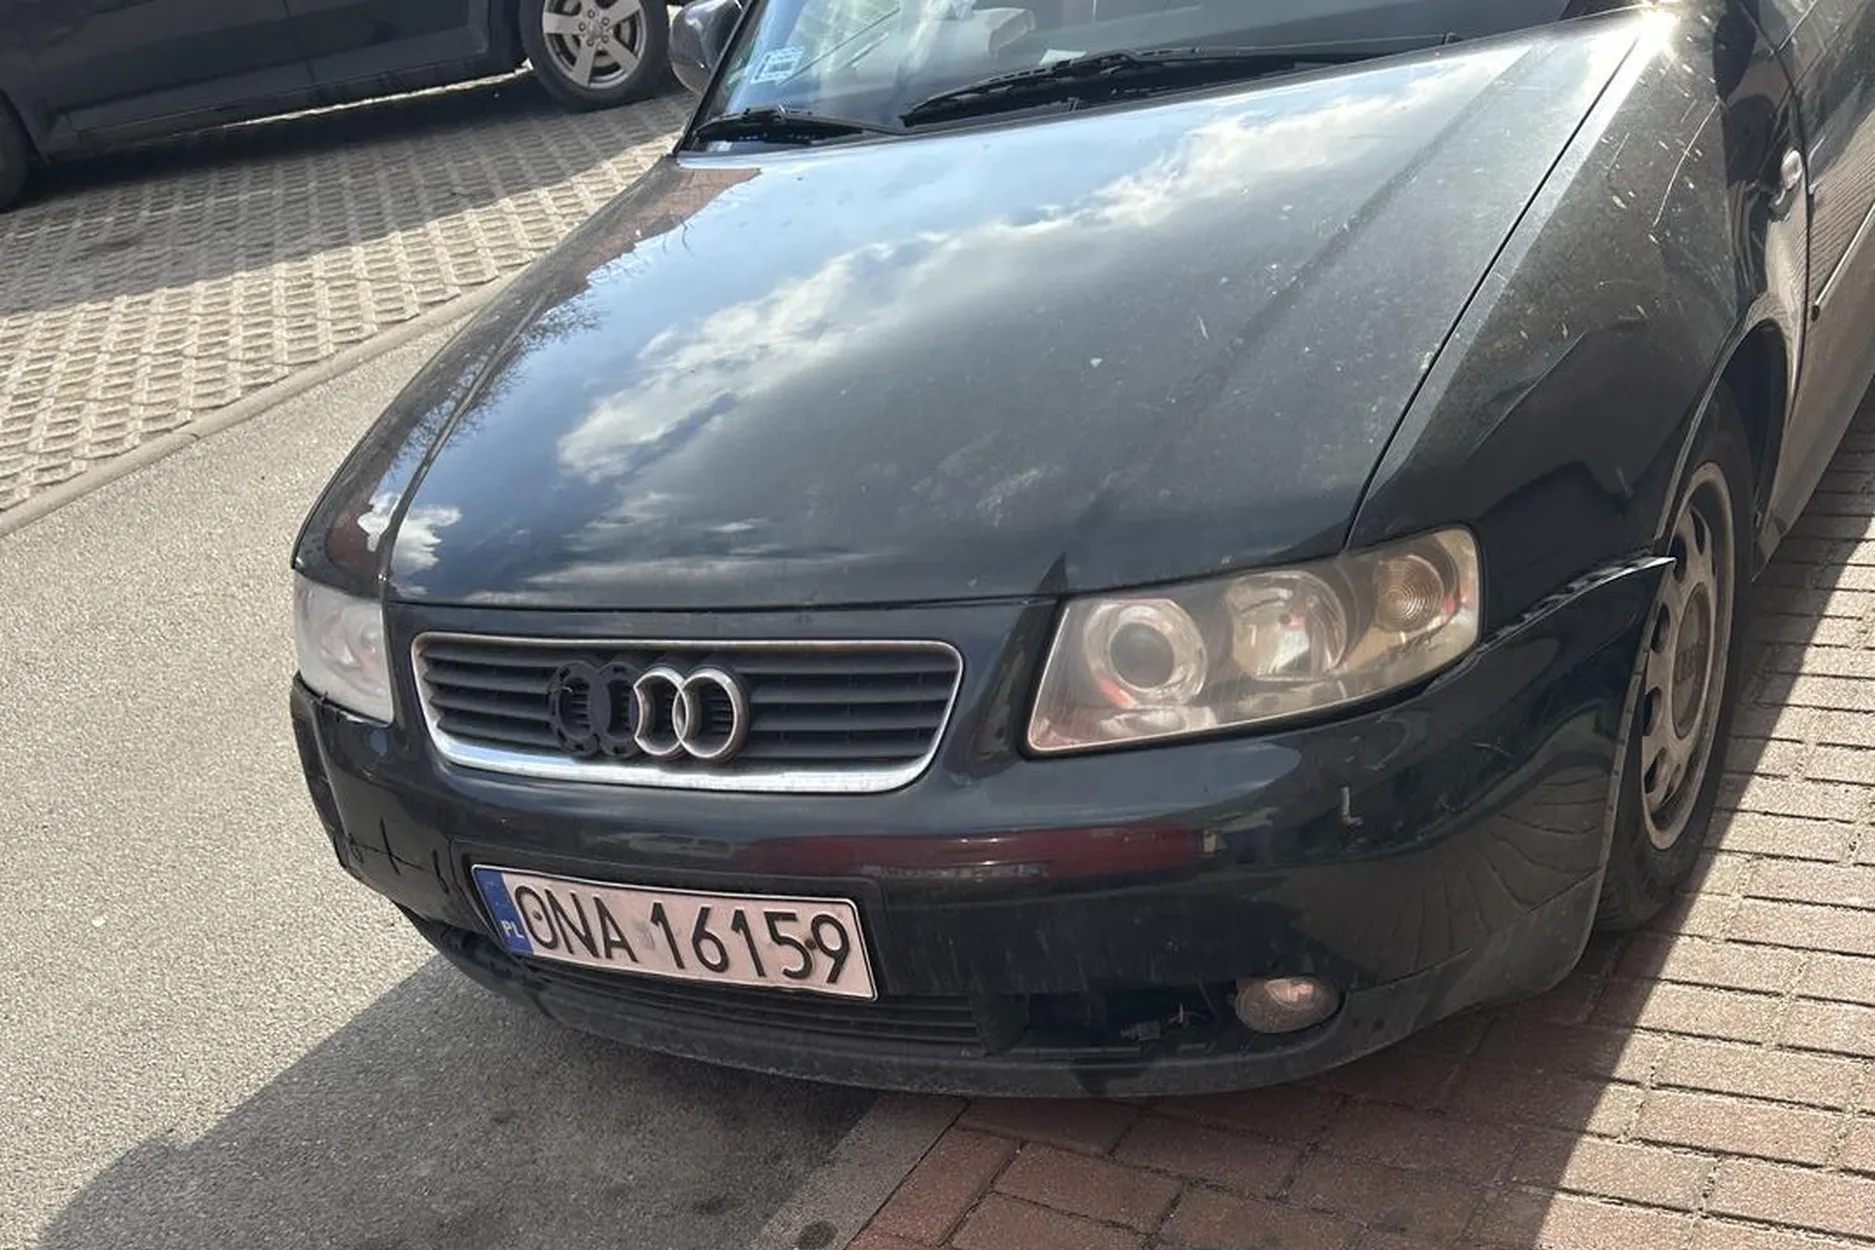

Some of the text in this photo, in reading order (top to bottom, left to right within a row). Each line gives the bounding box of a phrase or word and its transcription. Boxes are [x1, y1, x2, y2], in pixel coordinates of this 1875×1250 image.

[501, 919, 525, 939] PL
[515, 885, 850, 984] ONA 16159
